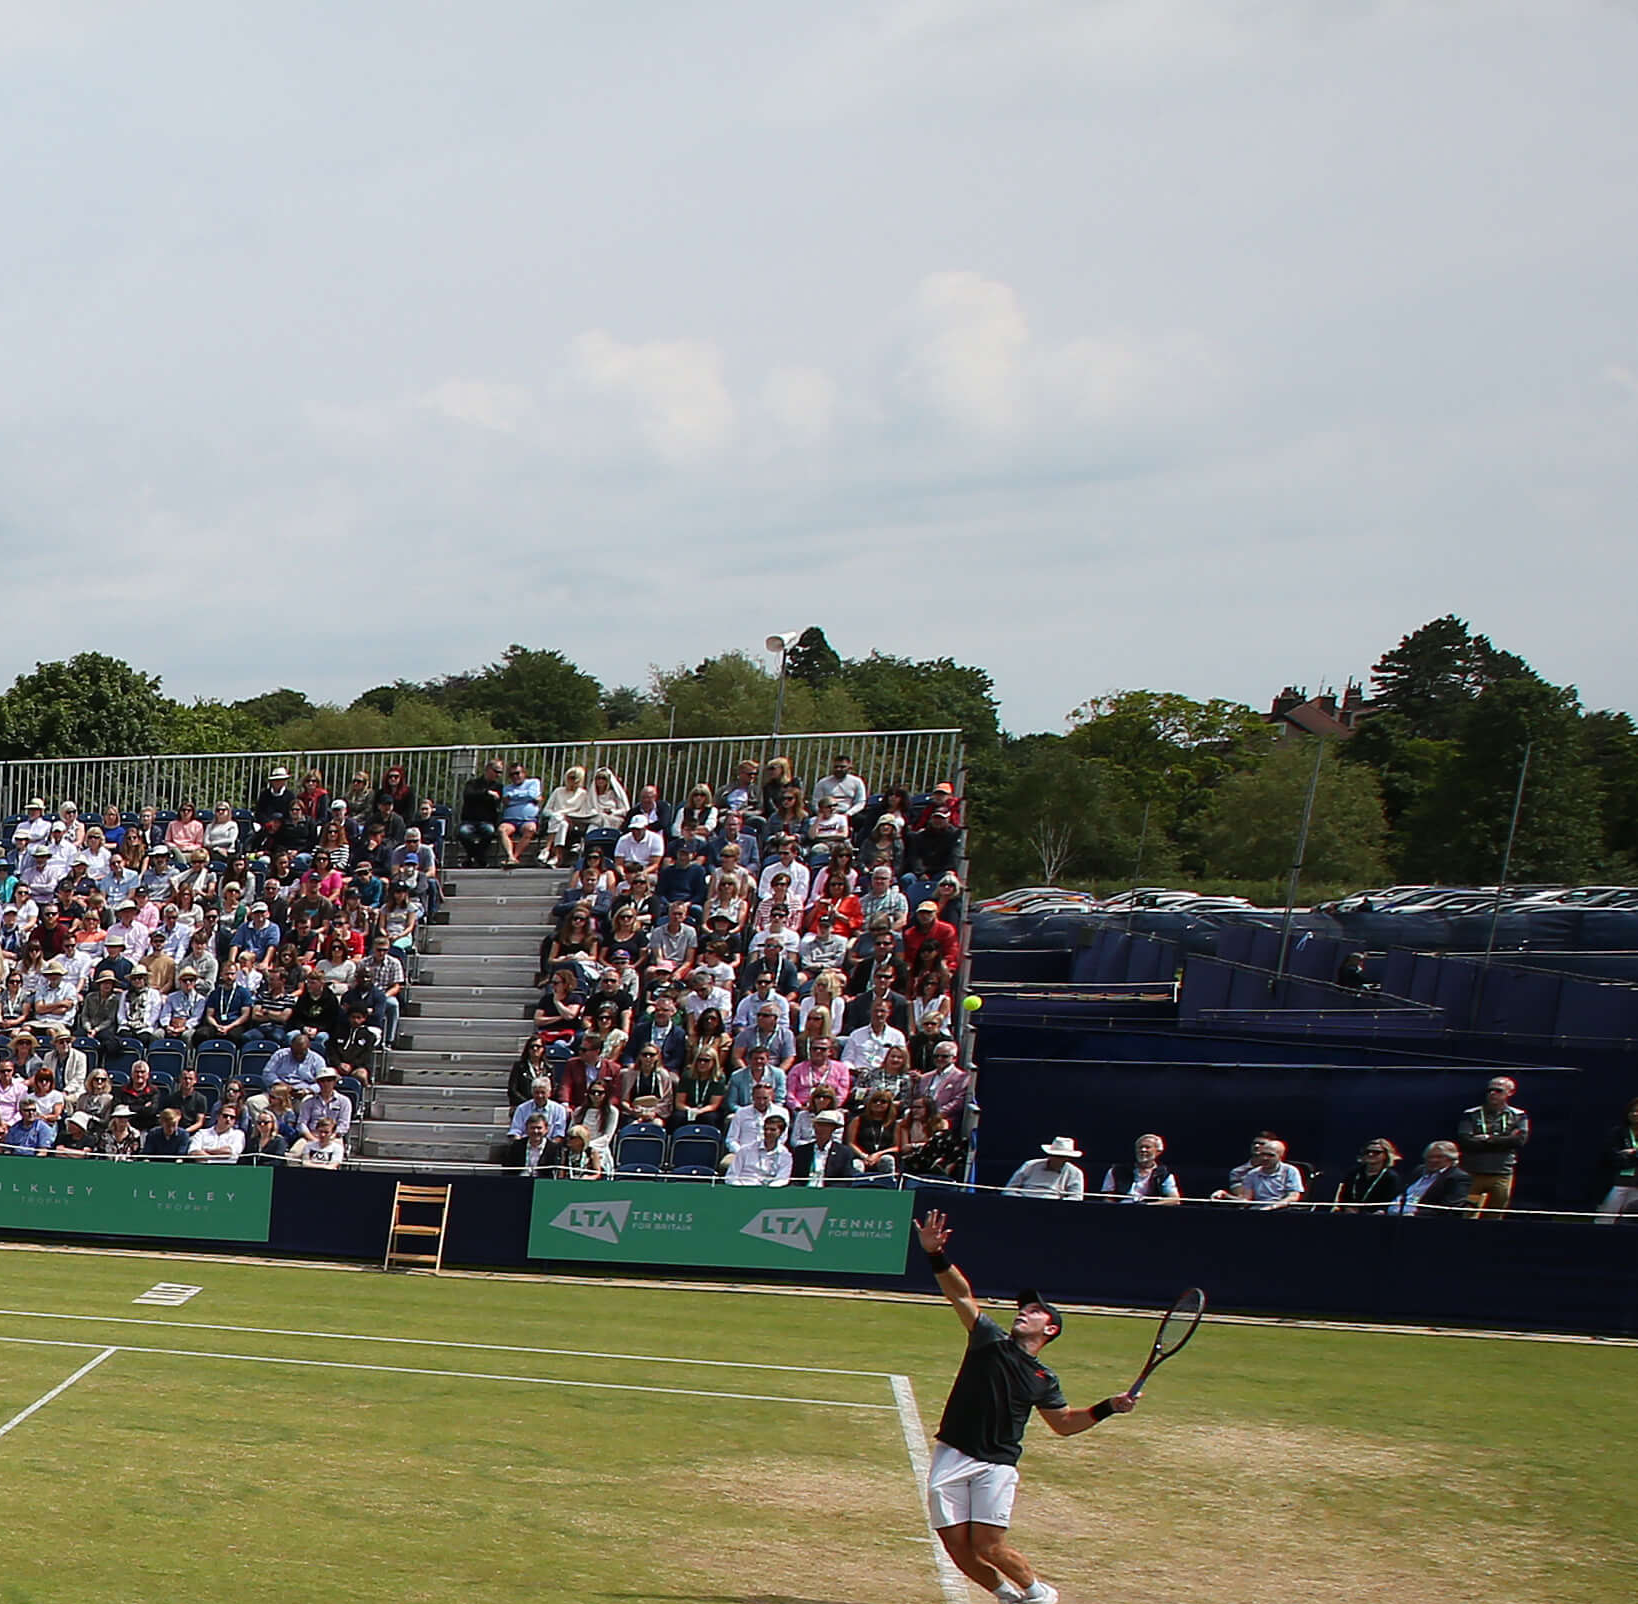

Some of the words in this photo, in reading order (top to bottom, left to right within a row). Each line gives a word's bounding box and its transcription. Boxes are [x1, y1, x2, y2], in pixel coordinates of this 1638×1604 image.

[133, 1188, 235, 1201] ILKLEY
[568, 1208, 624, 1239] LTA
[632, 1211, 694, 1224] TENNIS
[632, 1222, 654, 1231] FOR
[654, 1223, 693, 1232] BRITAIN
[761, 1215, 818, 1246] LTA
[828, 1217, 894, 1231] TENNIS
[828, 1230, 849, 1239] FOR
[850, 1230, 893, 1240] BRITAIN
